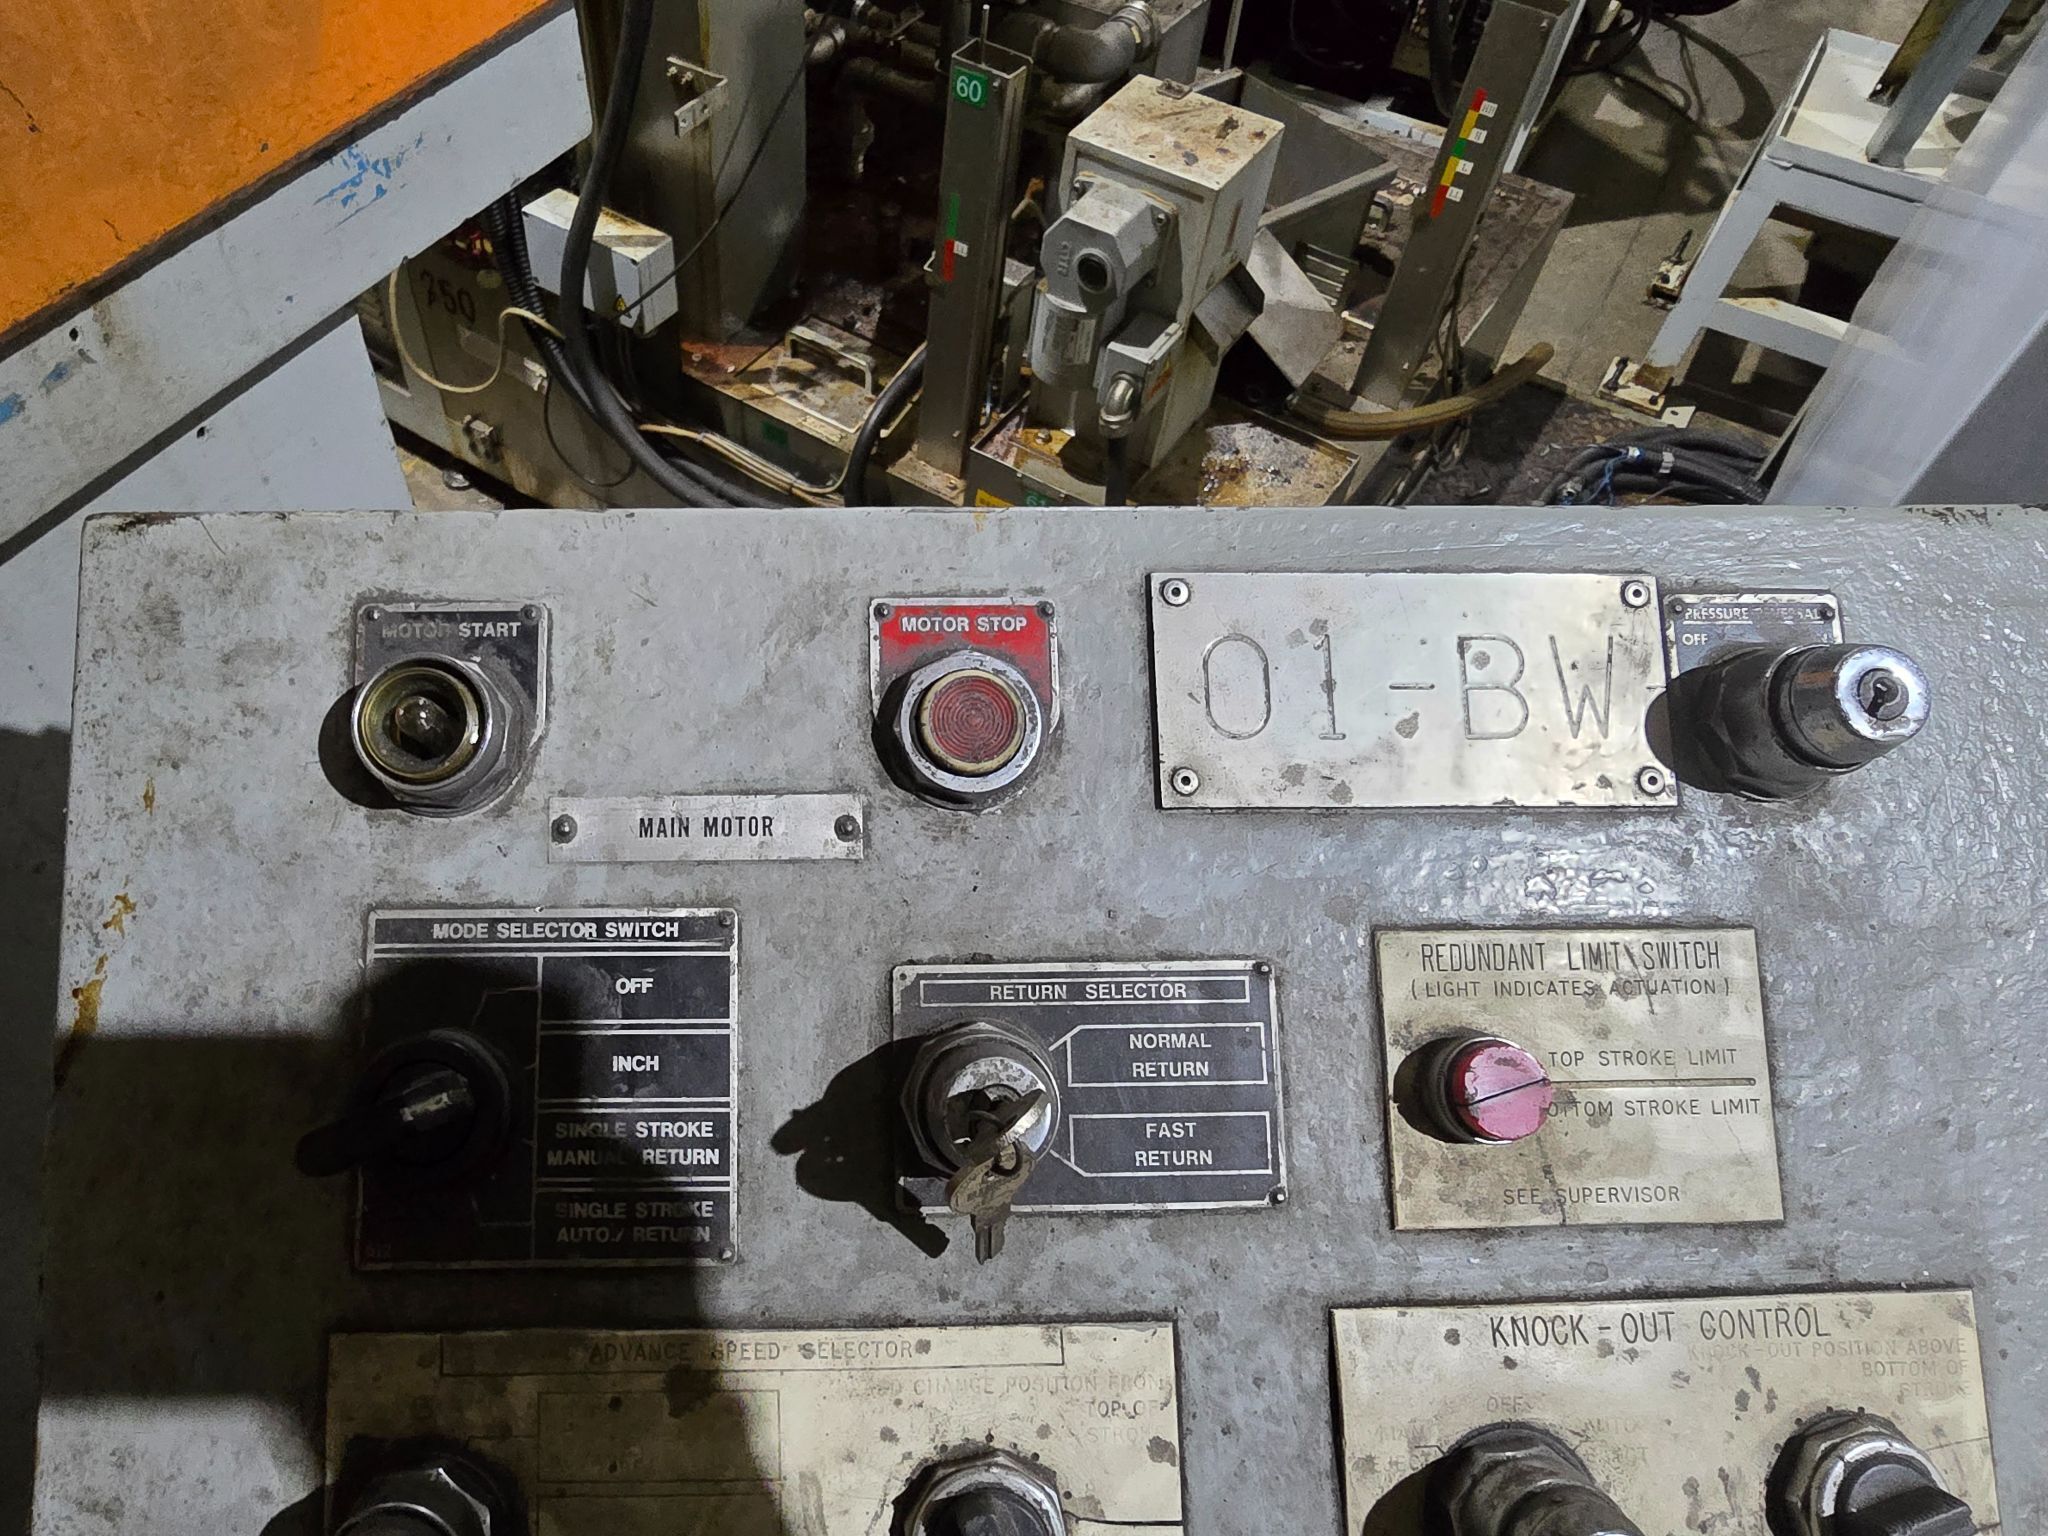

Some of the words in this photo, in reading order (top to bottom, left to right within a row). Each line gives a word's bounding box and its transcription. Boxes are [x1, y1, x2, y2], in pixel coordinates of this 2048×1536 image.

[956, 75, 982, 102] 60
[420, 268, 476, 324] 750
[1684, 607, 1750, 620] PRESSURE
[382, 621, 453, 639] MOTOR
[458, 621, 522, 638] START
[901, 616, 969, 633] MOTOR
[977, 615, 1028, 632] STOP
[1682, 633, 1708, 646] OFF
[638, 817, 691, 839] MAIN
[703, 816, 774, 838] MOTOR
[432, 923, 488, 940] MODE
[496, 922, 597, 939] SELECTOR
[604, 921, 679, 938] SWITCH
[1421, 942, 1546, 973] REDUNDANT
[1566, 942, 1620, 972] LIMIT
[1642, 941, 1721, 970] SWITCH
[615, 977, 654, 995] OFF
[989, 984, 1067, 1000] RETURN
[1085, 982, 1187, 999] SELECTOR
[1494, 980, 1595, 997] INDICATES
[1128, 1033, 1212, 1050] NORMAL
[611, 1055, 660, 1072] INCH
[1548, 1051, 1585, 1067] TOP
[1599, 1050, 1675, 1067] STROKE
[1689, 1048, 1738, 1065] LIMIT
[1132, 1061, 1210, 1077] RETURN
[1546, 1101, 1613, 1117] OTTOM
[1624, 1100, 1701, 1117] STROKE
[1711, 1098, 1761, 1115] LIMIT
[555, 1122, 627, 1139] SINGLE
[635, 1121, 714, 1138] STROKE
[1145, 1122, 1197, 1138] FAST
[547, 1150, 628, 1166] MANUAL
[642, 1148, 720, 1165] RETURN
[1135, 1150, 1213, 1166] RETURN
[1503, 1189, 1540, 1205] SEE
[1554, 1186, 1681, 1205] SUPERVISOR
[555, 1202, 627, 1218] SINGLE
[635, 1201, 714, 1218] STROKE
[633, 1225, 711, 1242] RETURN
[1700, 1308, 1831, 1341] CONTROL
[588, 1342, 691, 1364] ADVANCE
[711, 1341, 781, 1361] SPEED
[801, 1341, 913, 1360] SELECTOR
[1812, 1339, 1896, 1357] POSITION
[1906, 1338, 1967, 1355] ABOVE
[1862, 1360, 1936, 1378] BOTTOM
[1946, 1359, 1969, 1375] OF
[1006, 1375, 1097, 1394] POSITION
[1486, 1395, 1525, 1412] OFF
